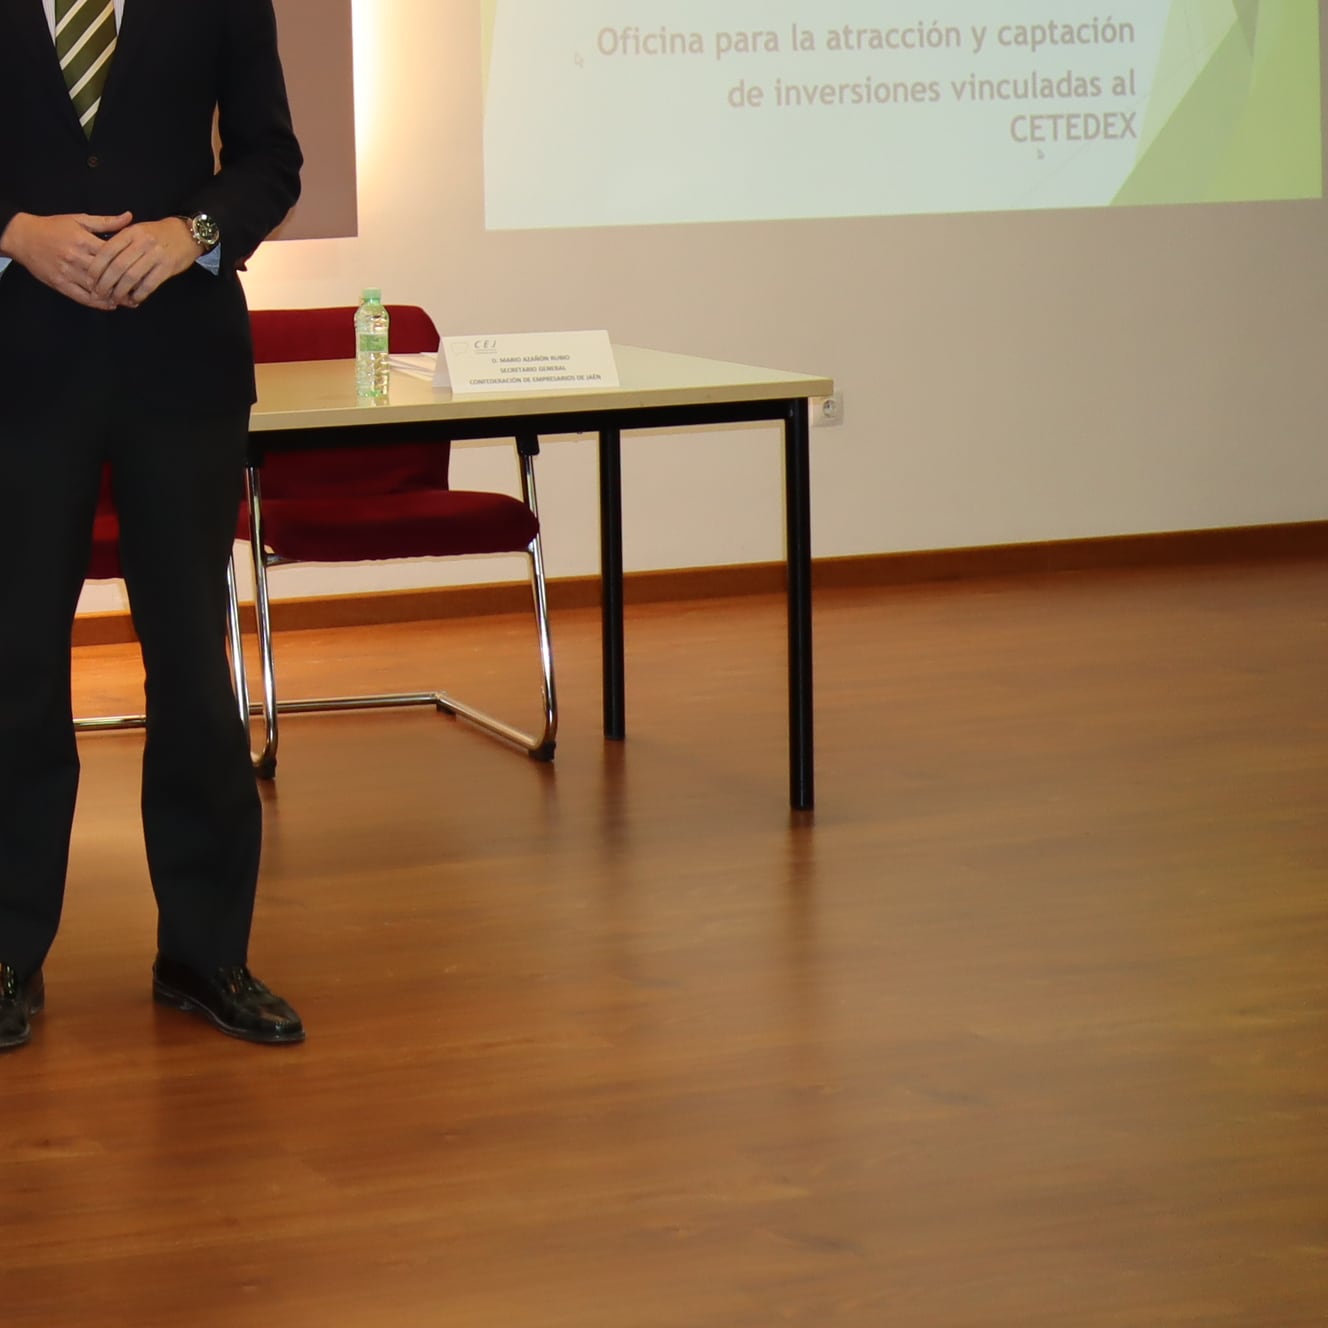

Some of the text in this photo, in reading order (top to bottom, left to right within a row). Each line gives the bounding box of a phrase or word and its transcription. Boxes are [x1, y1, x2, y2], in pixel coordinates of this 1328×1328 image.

[597, 14, 1135, 60] Oficina para la atracción y captación
[728, 68, 1136, 107] de inversiones vinculadas al
[1010, 111, 1137, 142] CETEDEX
